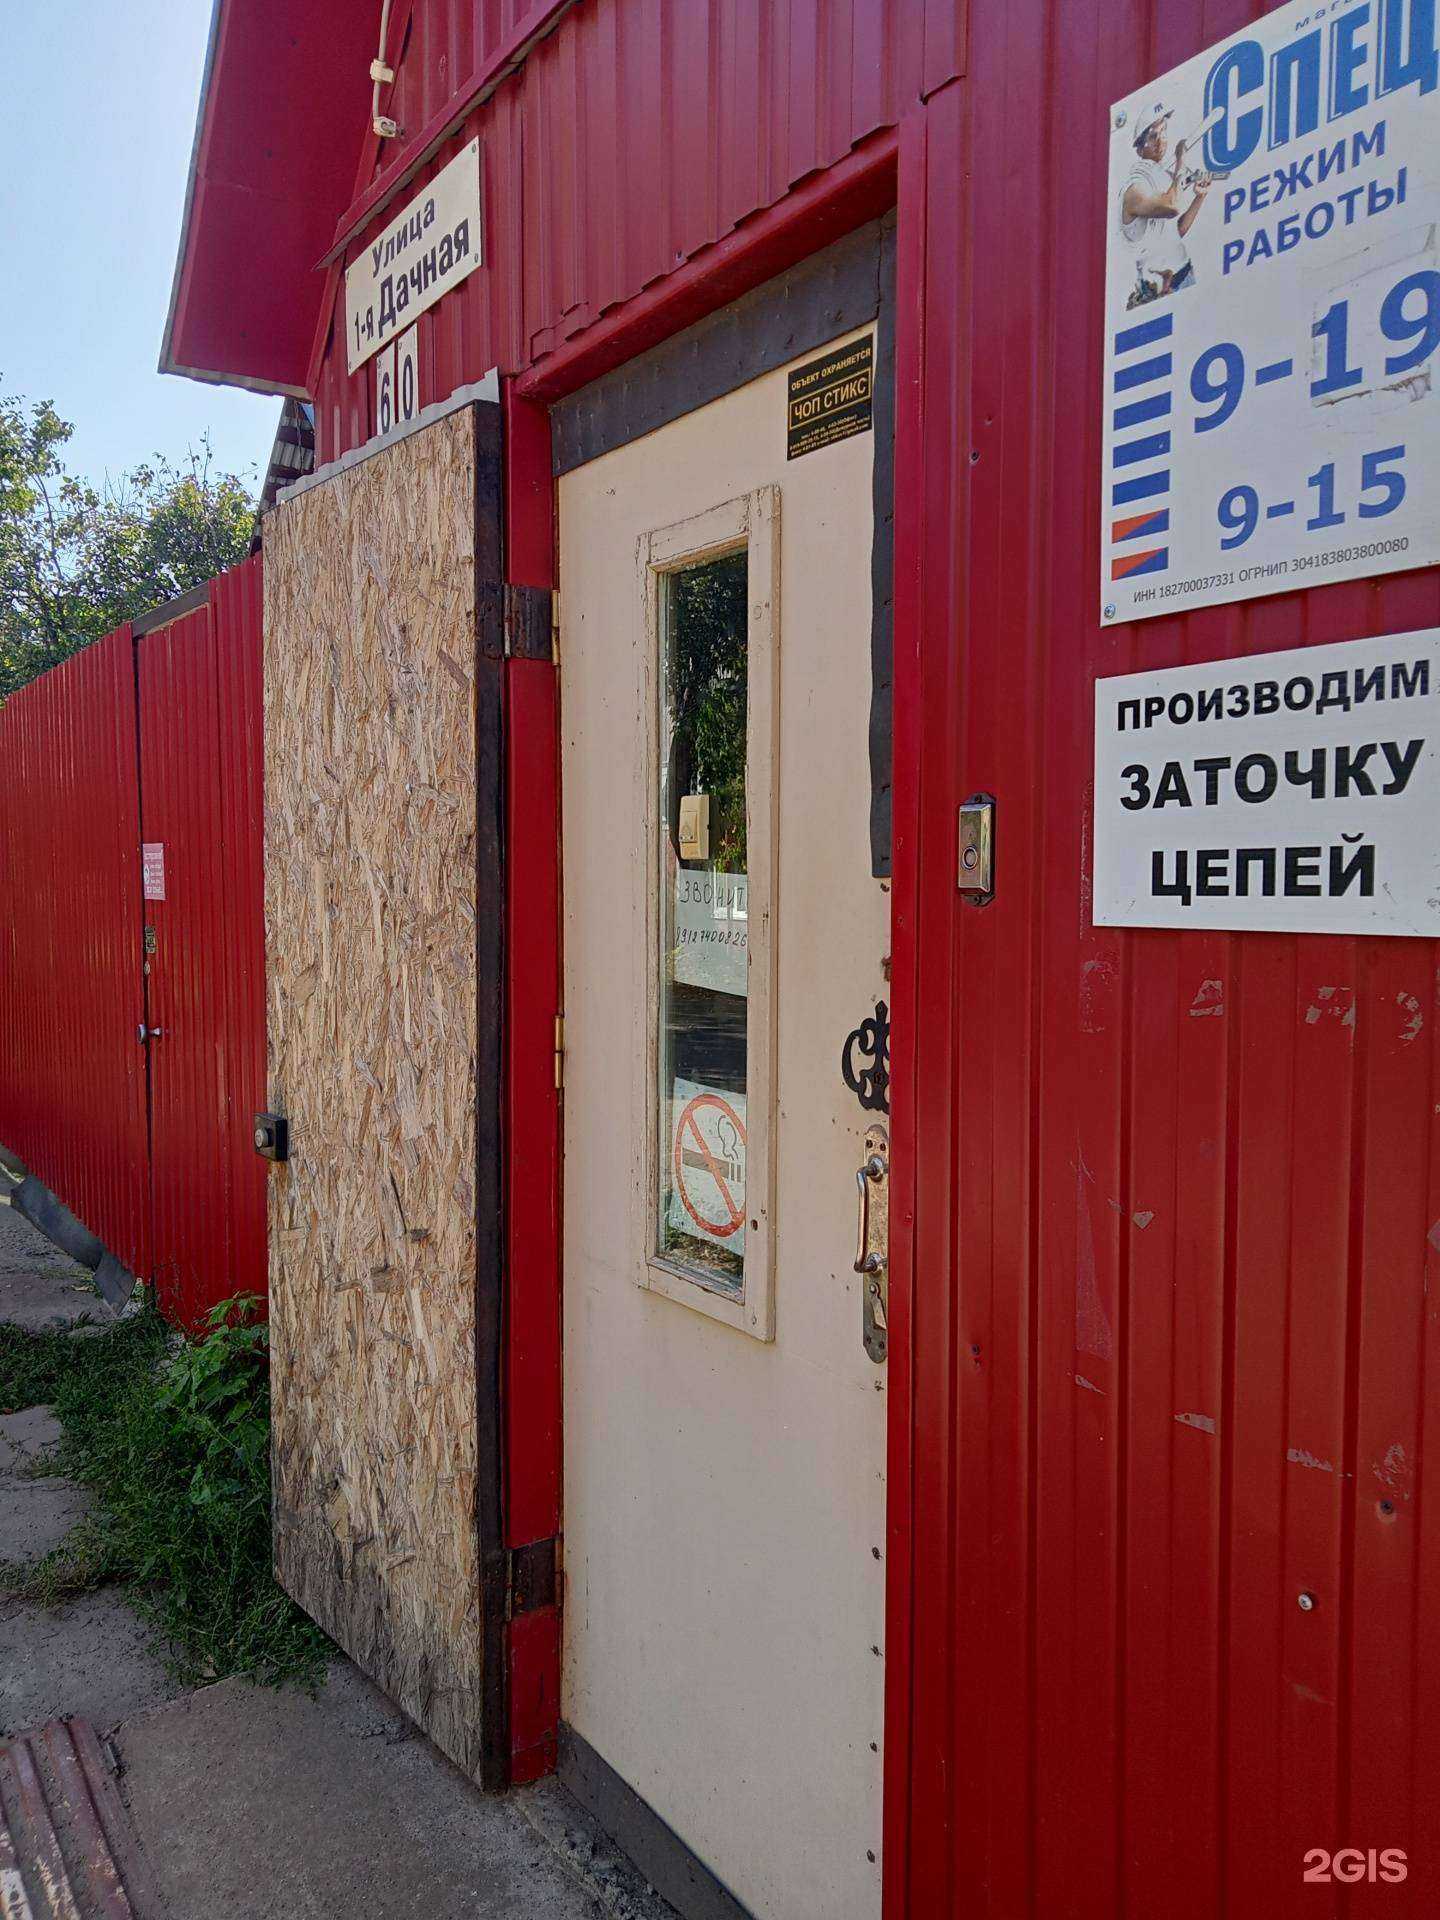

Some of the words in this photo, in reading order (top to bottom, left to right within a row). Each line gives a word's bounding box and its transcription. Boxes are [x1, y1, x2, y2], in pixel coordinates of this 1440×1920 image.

[1223, 120, 1386, 224] РЕЖИМ
[372, 198, 435, 278] Улица
[1222, 166, 1407, 275] РАБОТЫ
[354, 305, 374, 351] 1-я
[379, 218, 469, 337] Дачная
[791, 373, 820, 391] ОБЪЕКТ
[822, 348, 871, 377] ОХРАНЯЕТСЯ
[1190, 270, 1440, 433] 9-19
[795, 397, 820, 420] ЧОП
[824, 378, 867, 409] СТИКС
[1217, 444, 1407, 550] 9-15
[1133, 590, 1157, 603] ИНН
[1158, 572, 1235, 598] 182700037331
[1238, 561, 1288, 582] ОГРНИП
[1291, 537, 1409, 571] 304183803800080
[1117, 659, 1430, 731] ПРОИЗВОДИМ
[1120, 739, 1426, 811] ЗАТОЧКУ
[1151, 832, 1376, 906] ЦЕПЕЙ
